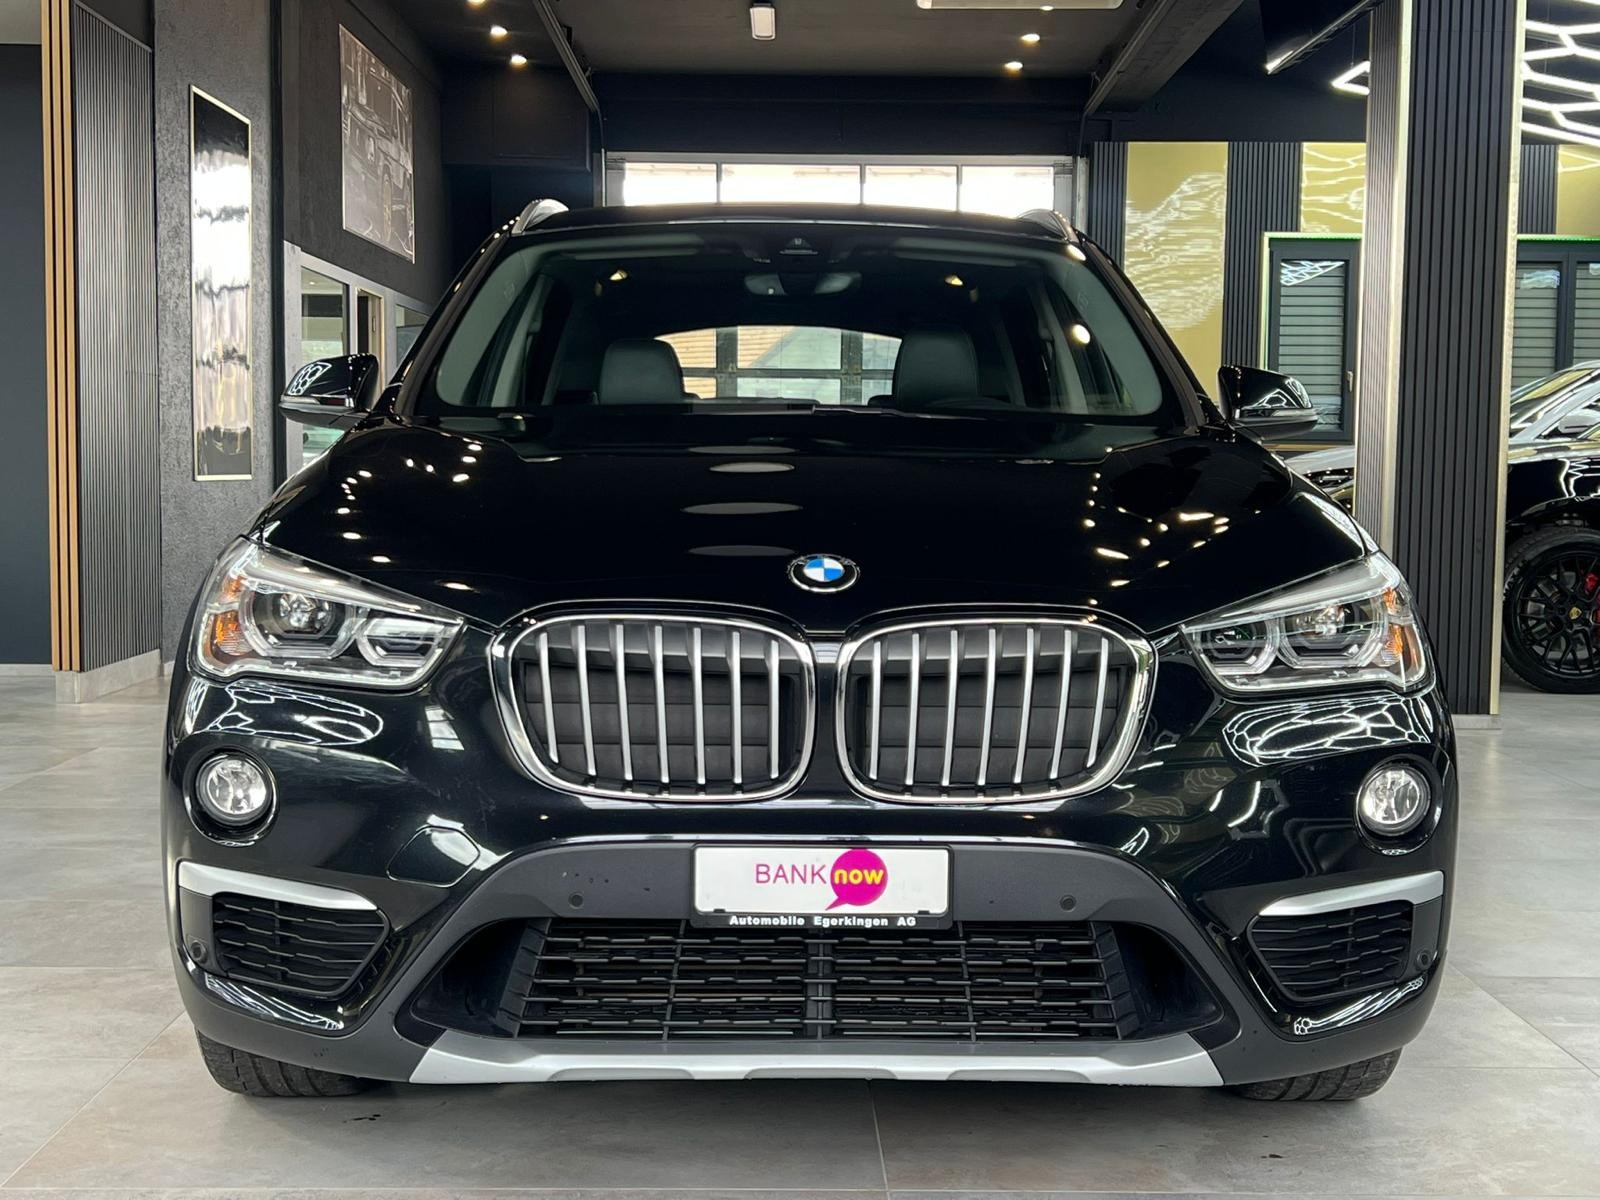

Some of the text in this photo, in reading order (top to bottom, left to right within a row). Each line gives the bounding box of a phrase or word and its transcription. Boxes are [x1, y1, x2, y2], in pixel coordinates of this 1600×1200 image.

[755, 863, 884, 885] BANK now
[729, 915, 917, 928] Automobile Egerkingen AG
